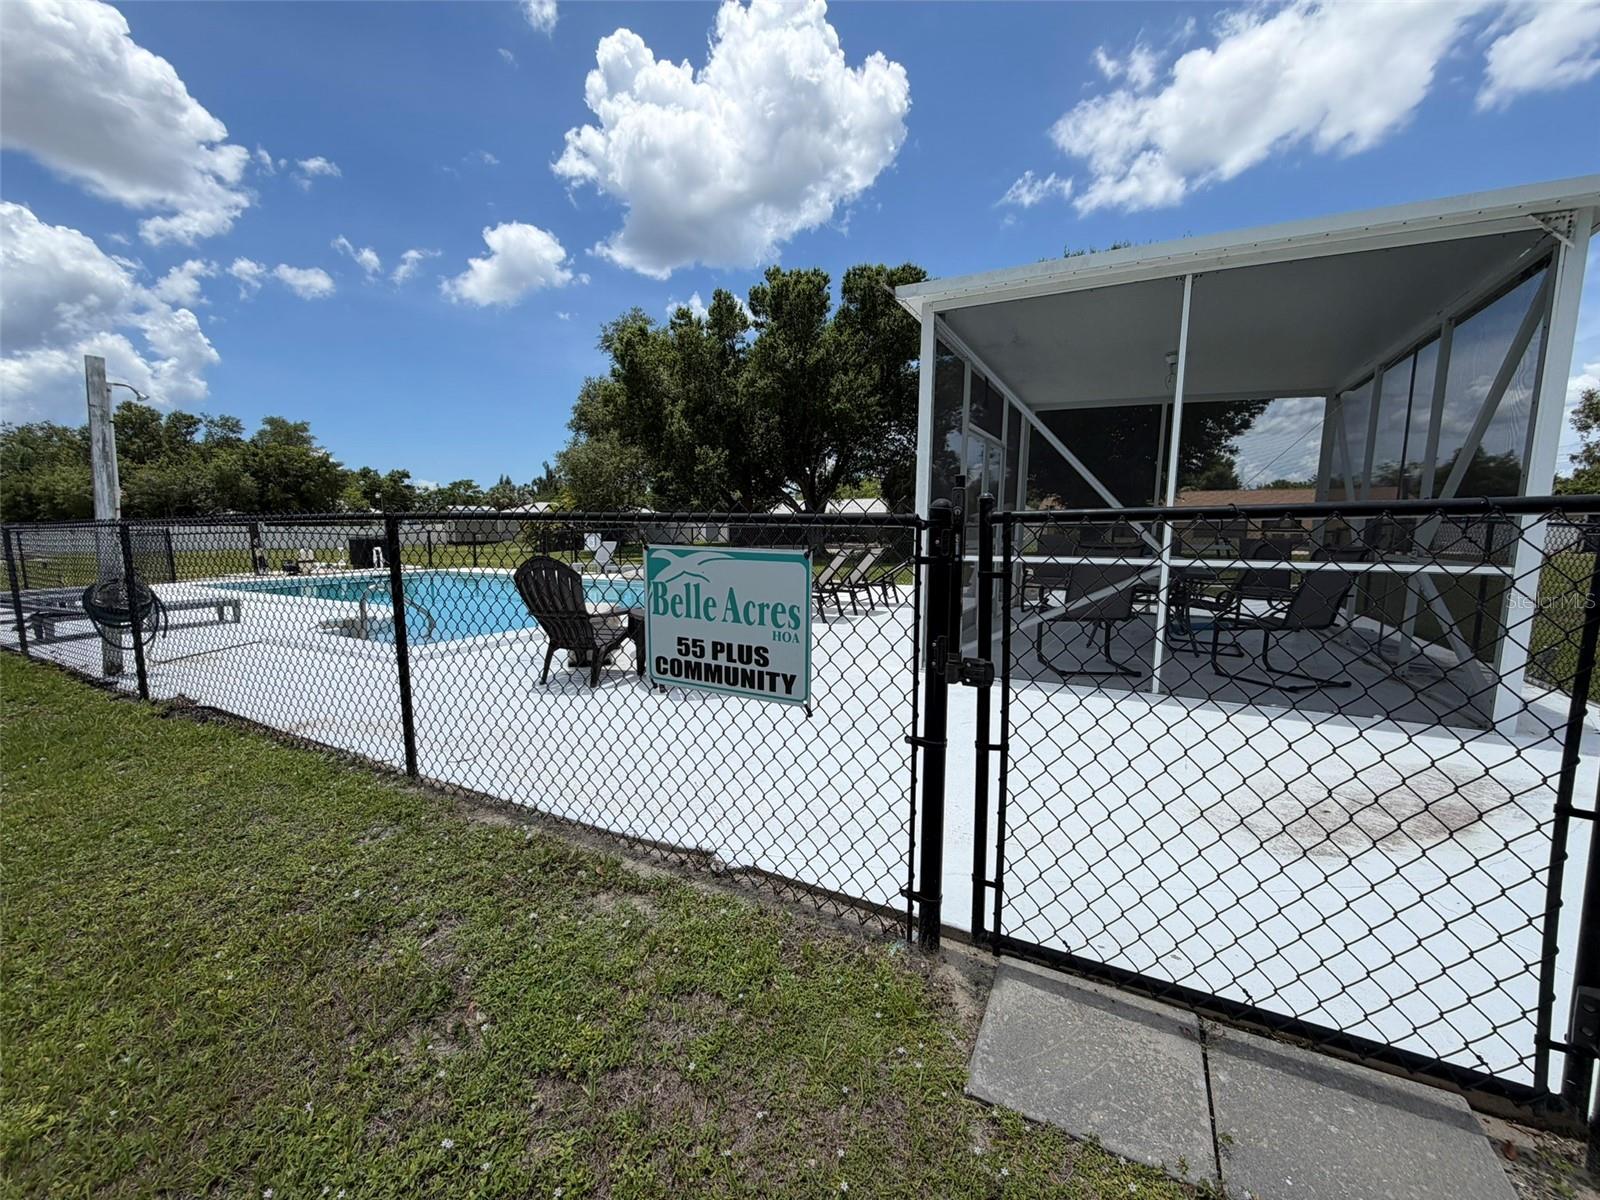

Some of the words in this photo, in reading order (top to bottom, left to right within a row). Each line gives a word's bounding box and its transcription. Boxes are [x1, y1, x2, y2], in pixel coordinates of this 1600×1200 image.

[652, 581, 717, 622] Belle
[722, 586, 801, 630] Acres
[676, 636, 706, 659] 55
[711, 640, 770, 668] PLUS
[772, 630, 800, 643] HOA
[655, 655, 797, 695] COMMUNITY
